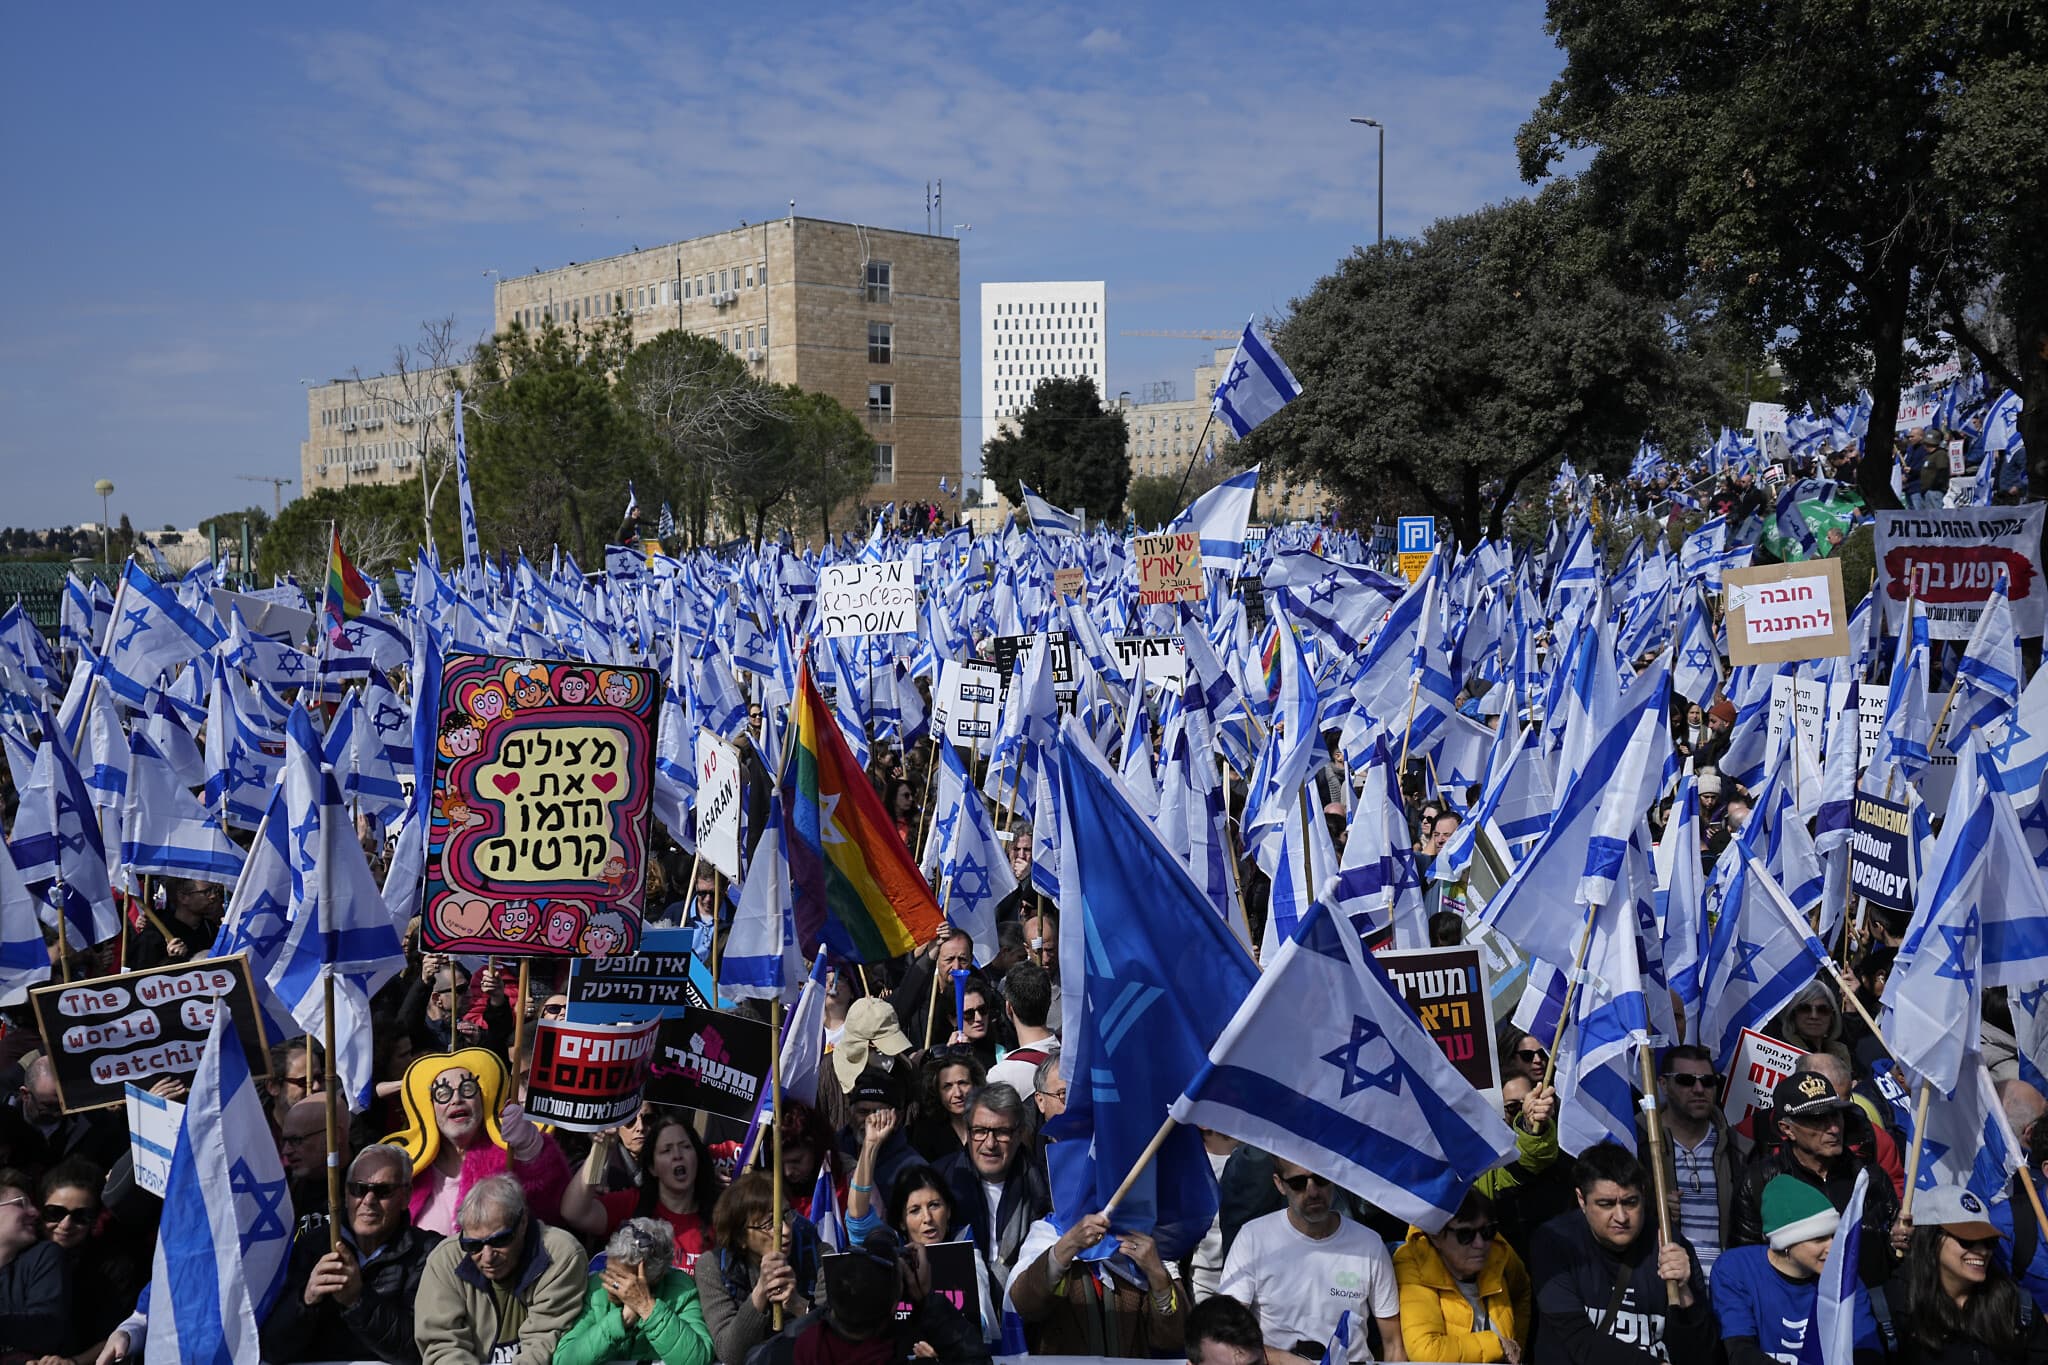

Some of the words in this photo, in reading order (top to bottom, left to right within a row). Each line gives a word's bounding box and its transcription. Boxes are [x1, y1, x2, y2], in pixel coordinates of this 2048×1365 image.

[1888, 519, 1977, 538] ההתגברות
[1136, 536, 1174, 555] עליתי
[1176, 533, 1194, 553] לא
[829, 563, 903, 586] מדינה
[1142, 554, 1184, 582] לארץ
[1160, 577, 1192, 589] בשביל
[1760, 586, 1813, 605] חובה
[825, 610, 904, 637] מוסרית
[1748, 608, 1830, 633] להתנגד
[962, 685, 992, 698] נאמנים
[501, 731, 617, 769] מצילים
[703, 751, 718, 784] NO
[530, 773, 585, 797] את
[489, 833, 607, 877] קרטיה
[594, 957, 650, 973] חופש
[655, 957, 686, 976] אין
[64, 991, 119, 1014] The
[141, 973, 228, 1001] whole
[580, 981, 644, 1001] הייטק
[649, 984, 680, 1003] אין
[1420, 1000, 1472, 1031] היא
[67, 1015, 156, 1049] world
[1755, 1043, 1779, 1056] תקום
[1780, 1053, 1794, 1062] לא
[665, 1046, 758, 1094] תתעוררי
[1767, 1057, 1793, 1071] להיות
[701, 1075, 728, 1091] הנשים
[729, 1085, 754, 1102] מחאת
[532, 1095, 574, 1118] השלטון
[574, 1100, 613, 1120] לאיכות
